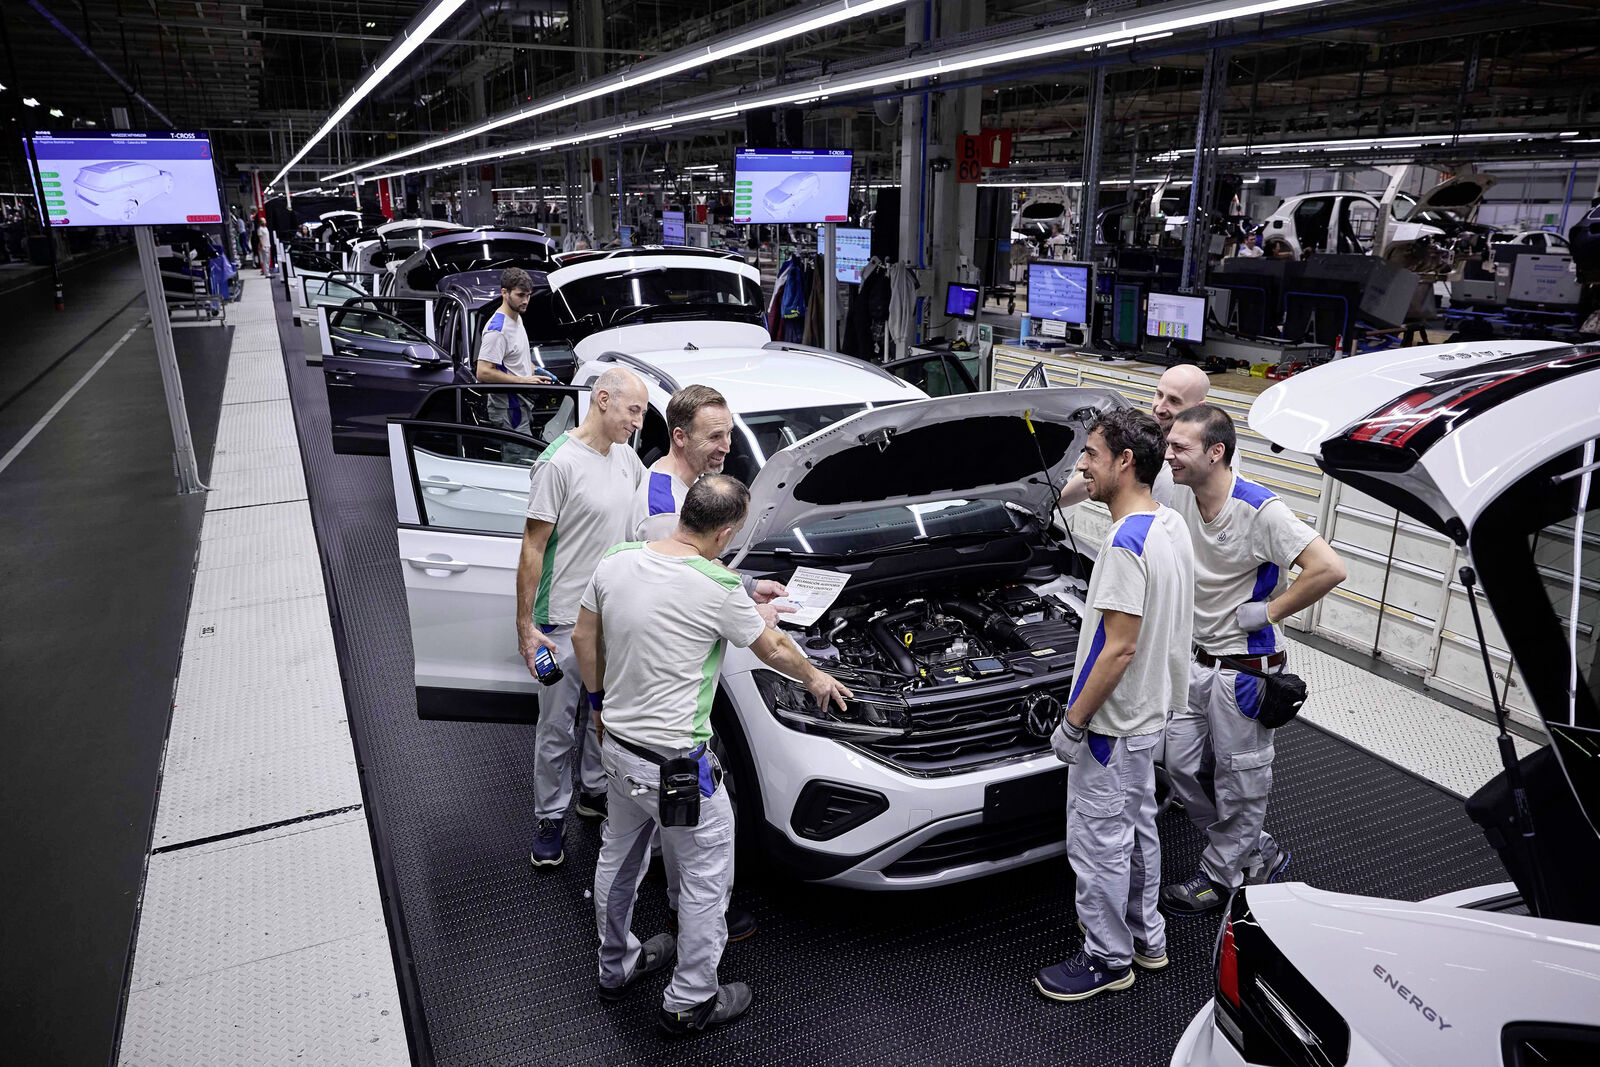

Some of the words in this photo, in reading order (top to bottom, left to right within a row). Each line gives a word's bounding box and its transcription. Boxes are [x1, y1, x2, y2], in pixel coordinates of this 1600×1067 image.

[200, 145, 209, 157] 2
[959, 160, 980, 179] 60
[1373, 964, 1453, 1031] ENERGY
